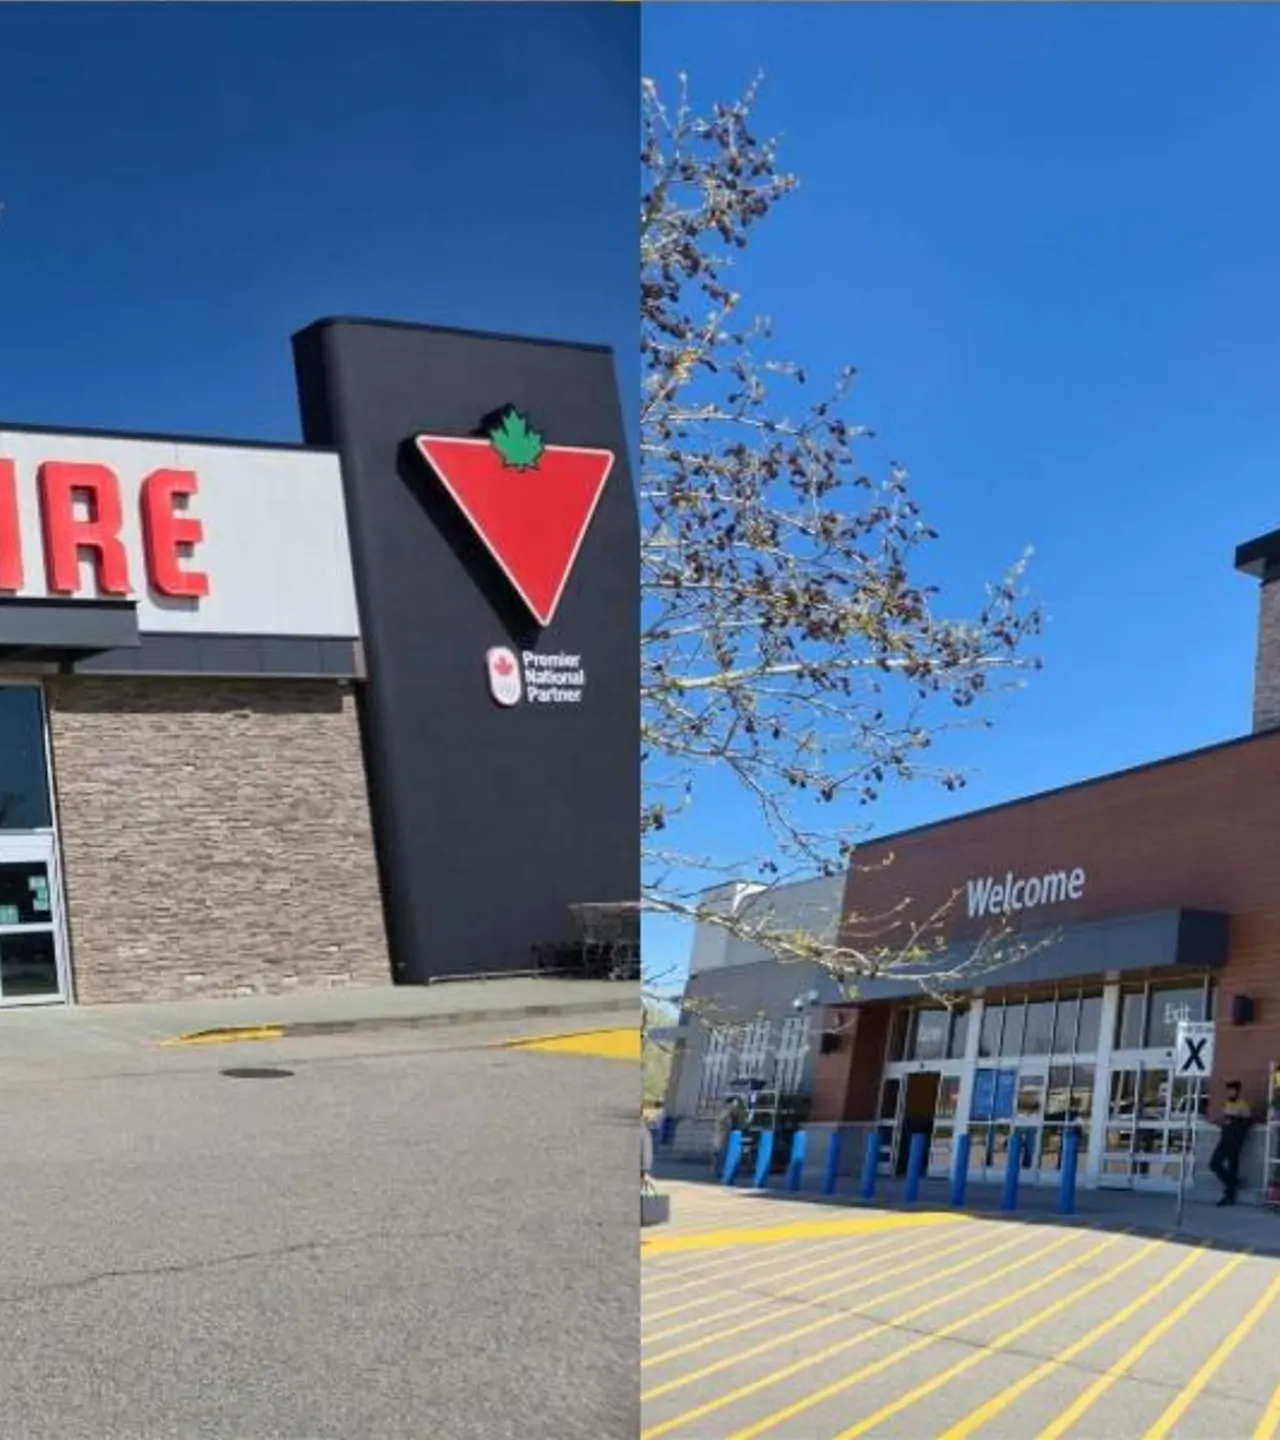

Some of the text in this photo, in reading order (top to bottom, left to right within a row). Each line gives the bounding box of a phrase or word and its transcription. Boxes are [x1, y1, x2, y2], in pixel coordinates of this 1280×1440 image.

[522, 650, 581, 668] Premier
[525, 669, 584, 685] National
[527, 686, 581, 703] Partner
[967, 867, 1085, 918] Welcome
